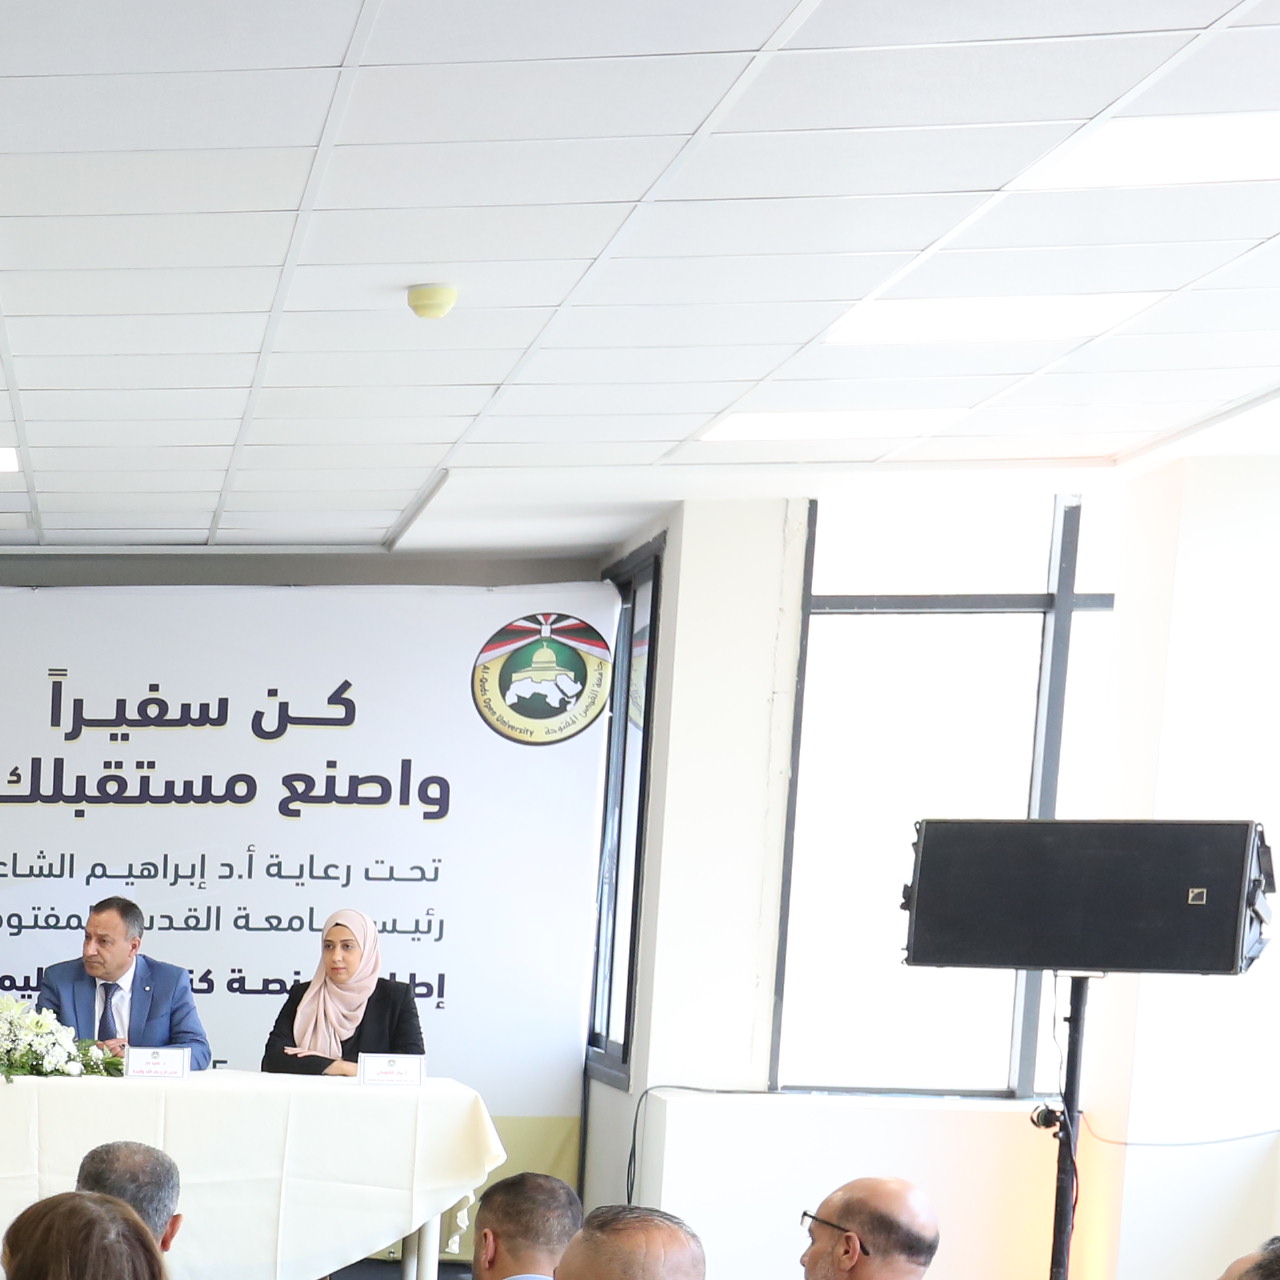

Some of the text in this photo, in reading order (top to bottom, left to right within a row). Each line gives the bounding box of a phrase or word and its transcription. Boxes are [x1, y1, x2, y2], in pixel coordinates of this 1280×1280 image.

[592, 661, 607, 691] جامعة
[47, 668, 358, 742] كن سفيراً
[482, 697, 497, 717] Open
[495, 715, 535, 738] University
[278, 758, 452, 821] واصنع
[85, 852, 208, 890] إبراهيم
[217, 844, 256, 881] أ.د
[266, 854, 352, 887] رعاية
[362, 858, 442, 883] تحت
[232, 905, 323, 933] امعة
[226, 966, 301, 996] نصة
